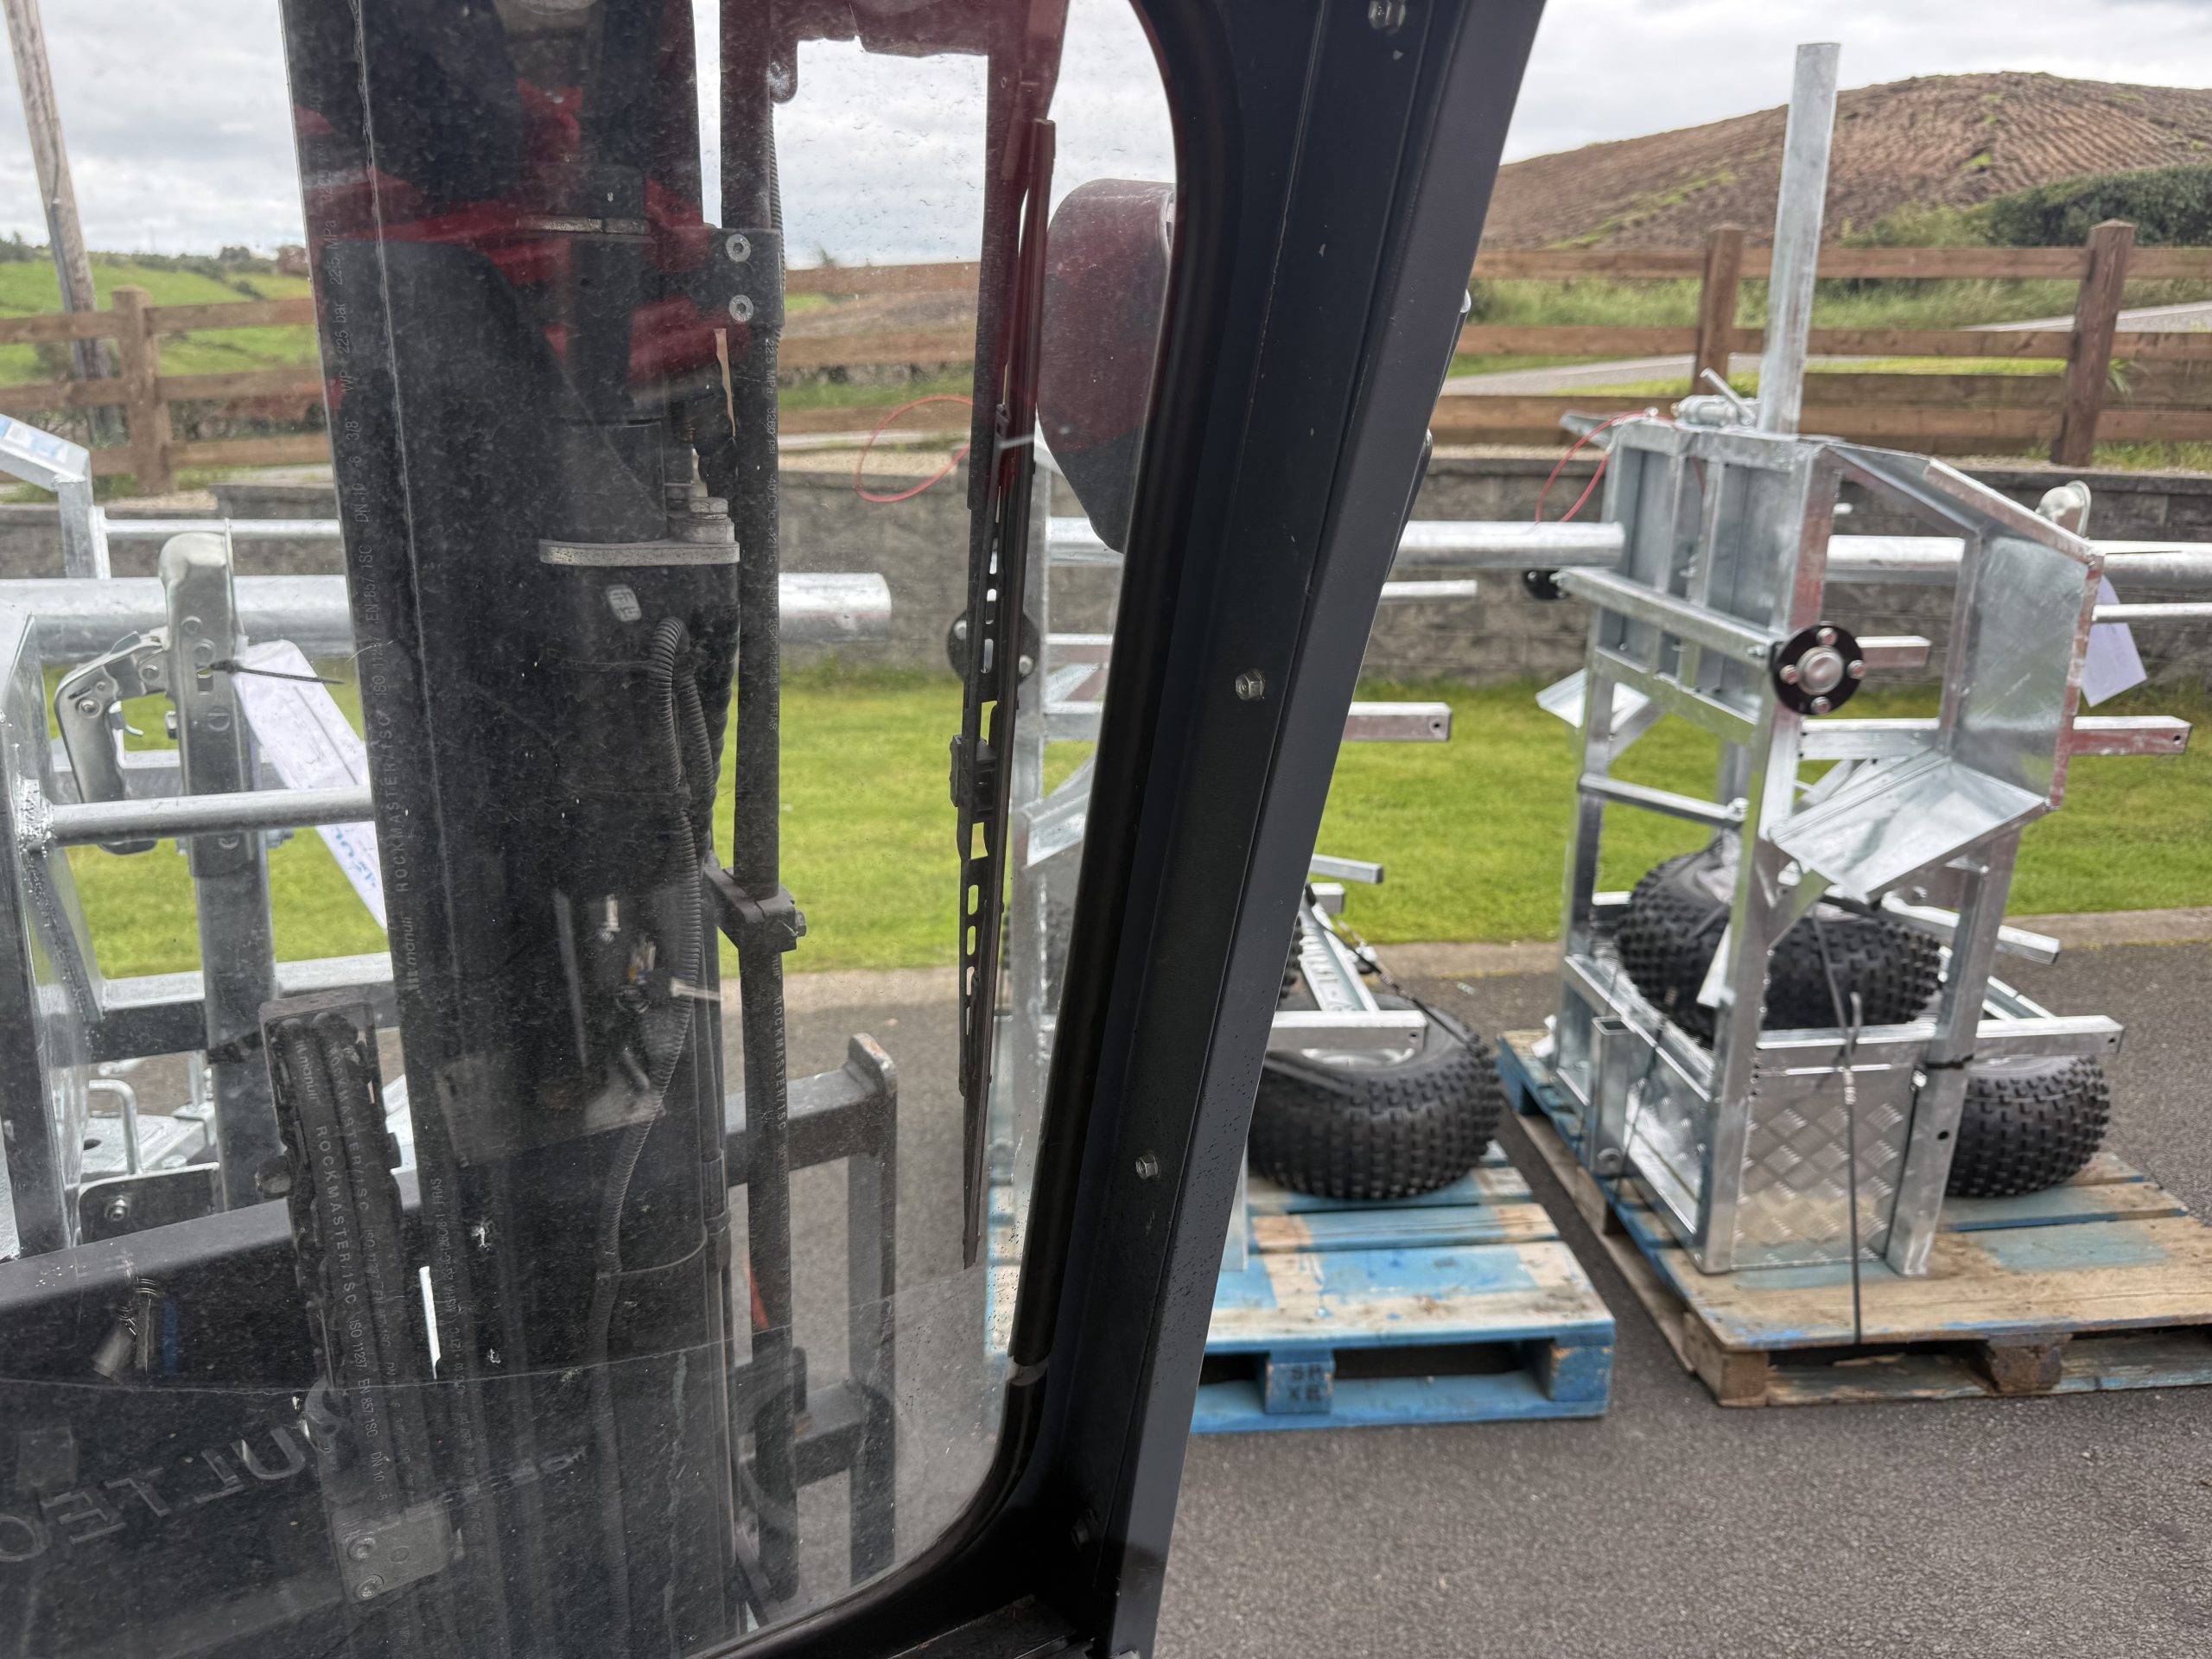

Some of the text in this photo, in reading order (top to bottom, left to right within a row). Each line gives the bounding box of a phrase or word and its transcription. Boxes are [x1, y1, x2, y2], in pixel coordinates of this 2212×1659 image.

[324, 220, 339, 250] MPa
[328, 256, 343, 285] 22.5
[334, 302, 347, 323] bar
[335, 330, 350, 353] 225
[340, 370, 354, 391] WP
[766, 371, 776, 394] MPa
[767, 440, 776, 454] psi
[354, 504, 370, 523] DN
[362, 577, 377, 598] 857
[364, 603, 379, 621] EN
[372, 675, 388, 696] ISO
[315, 1127, 358, 1306] ROCKMASTER/1SC
[348, 1319, 362, 1338] ISO
[352, 1343, 367, 1369] 11237
[358, 1378, 370, 1395] EN
[359, 1397, 373, 1414] 857
[364, 1419, 378, 1439] 1SC
[371, 1452, 384, 1467] DN
[372, 1470, 385, 1482] 10
